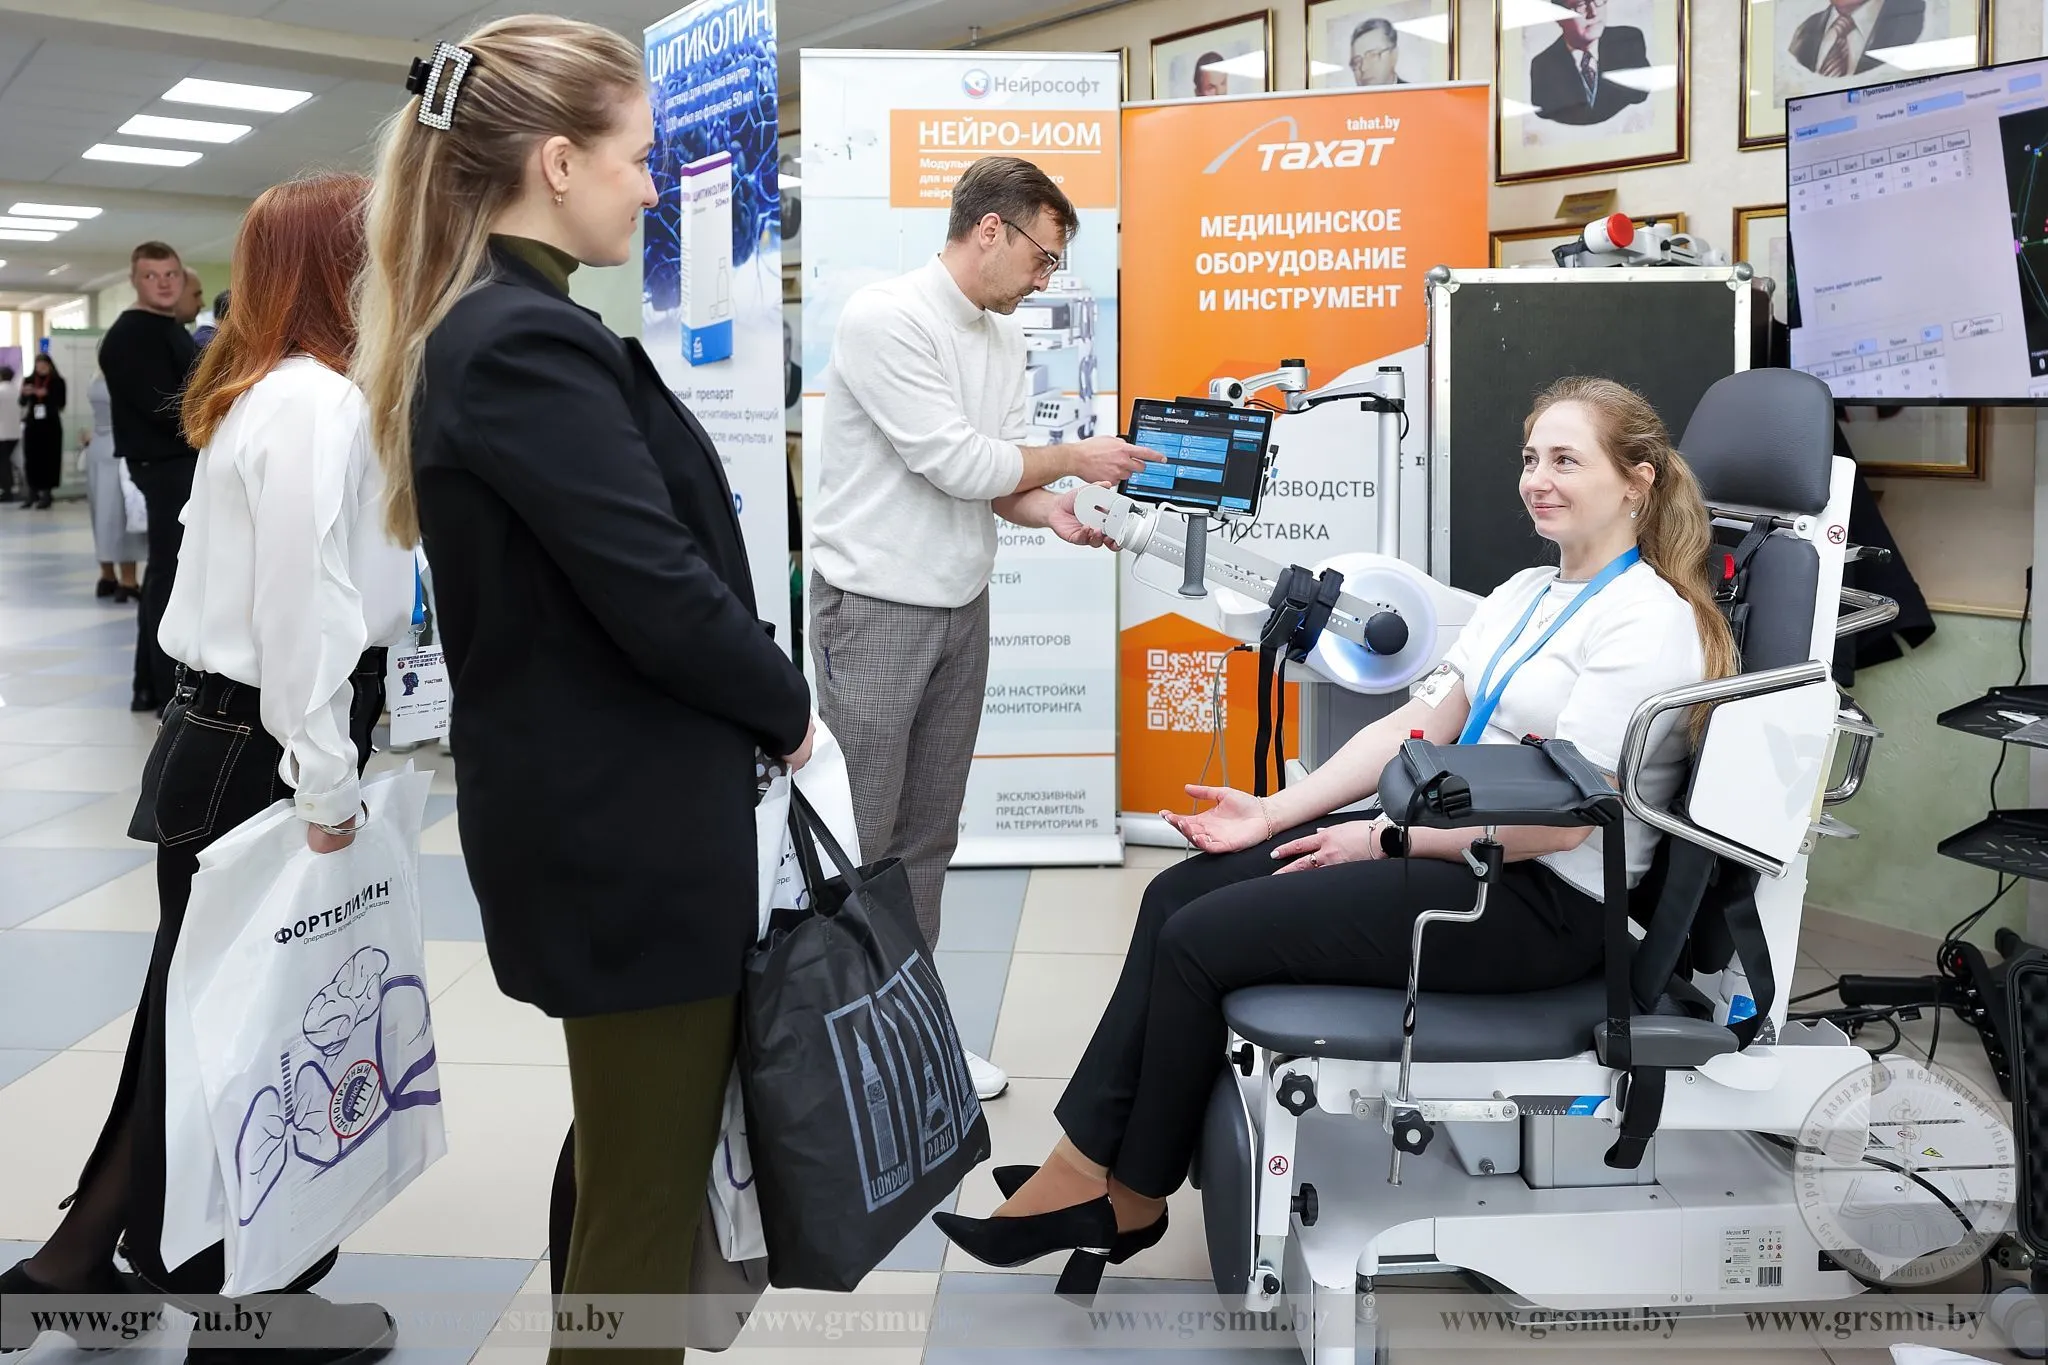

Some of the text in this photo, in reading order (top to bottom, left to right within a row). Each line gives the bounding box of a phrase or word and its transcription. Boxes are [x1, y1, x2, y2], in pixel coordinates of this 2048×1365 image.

[649, 0, 769, 86] ЦИТИКОЛИН
[994, 77, 1100, 96] Нейрософт
[733, 91, 743, 107] 50
[743, 90, 754, 103] мл
[1346, 115, 1400, 131] tahat.by
[919, 117, 1101, 146] НЕЙРО-ИОМ
[920, 174, 940, 184] для
[1201, 208, 1401, 241] МЕДИЦИНСКОЕ
[1196, 247, 1406, 277] ОБОРУДОВАНИЕ
[1199, 284, 1402, 311] И ИНСТРУМЕНТ
[696, 389, 733, 403] препарат
[744, 407, 779, 423] функций
[728, 433, 766, 446] инсультов
[1059, 479, 1073, 489] 64
[1264, 480, 1376, 501] ИЗВОДСТВ
[1009, 683, 1086, 697] НАСТРОЙКИ
[986, 702, 1082, 714] МОНИТОРИНГА
[996, 789, 1086, 802] ЭКСКЛЮЗИВНЫЙ
[996, 805, 1085, 818] ПРЕДСТАВИТЕЛЬ
[996, 818, 1098, 830] НА ТЕРРИТОРИИ РБ
[274, 879, 390, 945] ФОРТЕЛИИН
[927, 1127, 953, 1161] PARIS
[871, 1161, 909, 1199] LONDON
